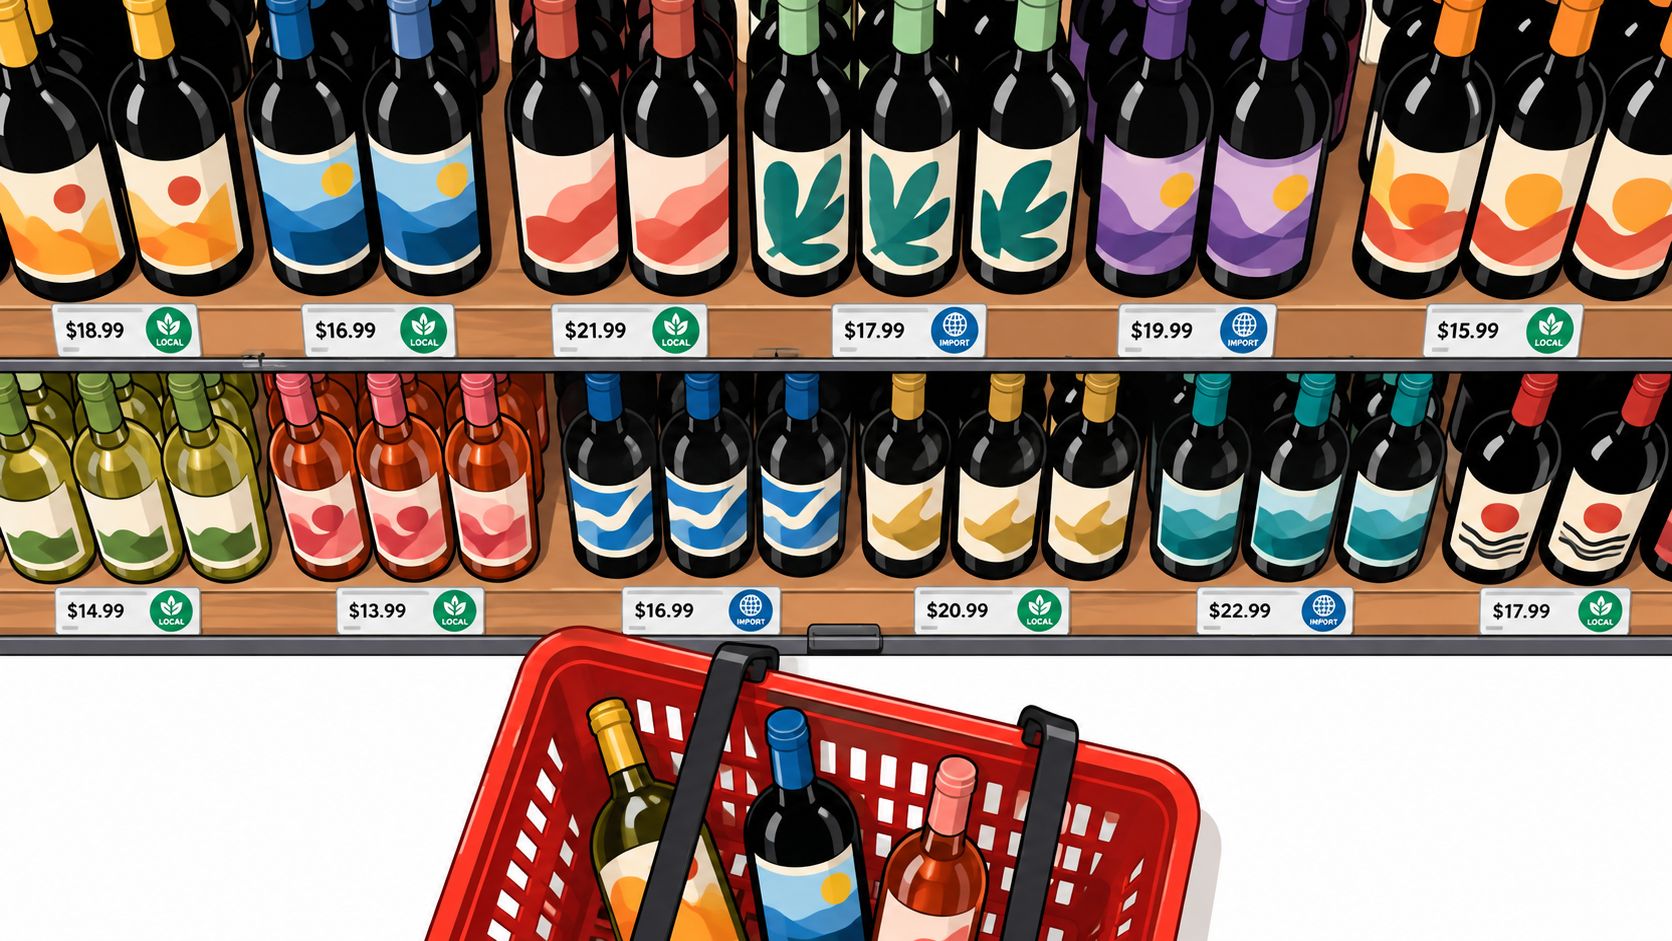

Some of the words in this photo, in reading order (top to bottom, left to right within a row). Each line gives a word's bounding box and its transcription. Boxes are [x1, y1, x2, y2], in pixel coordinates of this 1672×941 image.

[66, 321, 124, 340] $18.99
[316, 321, 375, 340] $16.99
[566, 321, 626, 340] $21.99
[845, 321, 904, 340] $17.99
[1132, 321, 1192, 340] $19.99
[1438, 321, 1498, 340] $15.99
[156, 338, 184, 346] LOCAL
[410, 338, 439, 346] LOCAL
[662, 338, 691, 346] LOCAL
[67, 601, 124, 619] $14.99
[349, 601, 405, 619] $13.99
[636, 601, 694, 619] $16.99
[927, 601, 988, 619] $20.99
[1210, 601, 1270, 619] $22.99
[1493, 602, 1550, 619] $17.99
